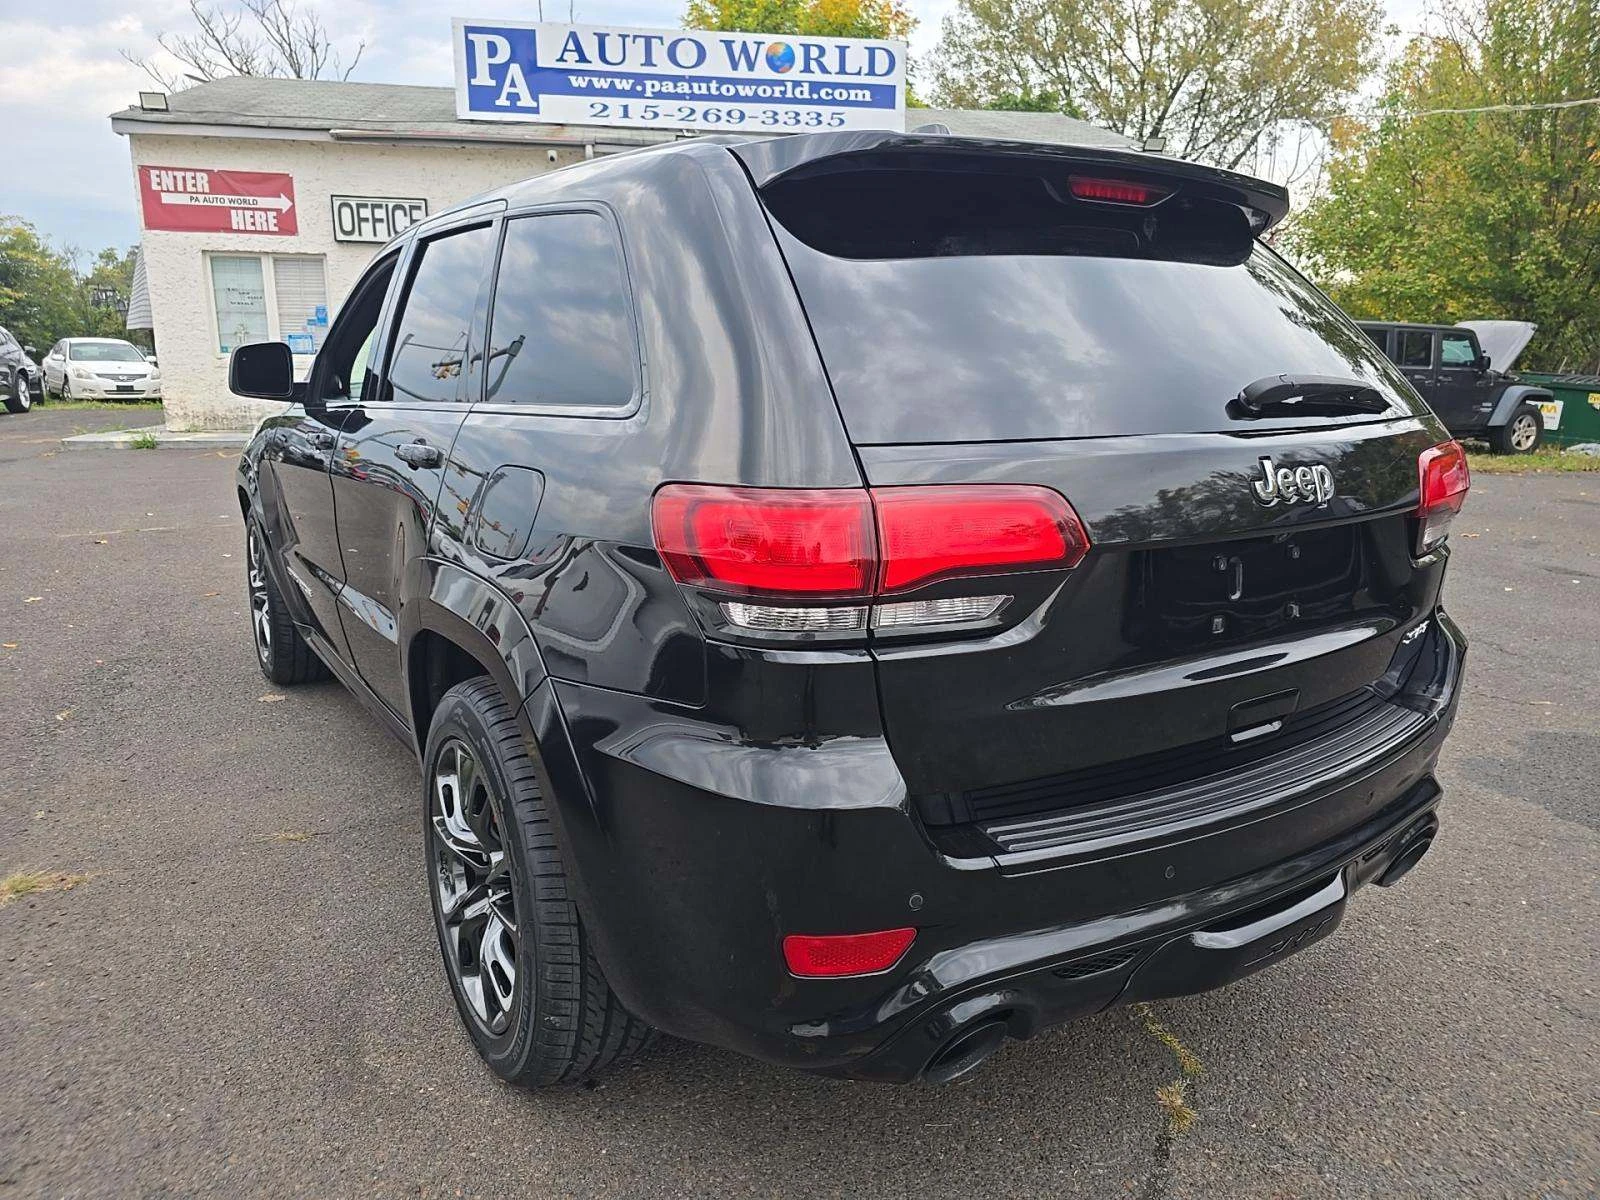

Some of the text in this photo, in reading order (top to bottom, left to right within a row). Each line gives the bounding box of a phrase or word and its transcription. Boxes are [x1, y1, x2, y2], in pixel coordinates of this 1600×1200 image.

[555, 30, 897, 78] AUTO WORLD
[568, 73, 873, 102] www.paautoworld.com
[589, 102, 846, 128] 215-269-3335
[150, 169, 210, 193] ENTER
[189, 195, 258, 206] PA AUTO WORLD
[230, 209, 279, 232] HERE
[1253, 455, 1335, 505] Jeep
